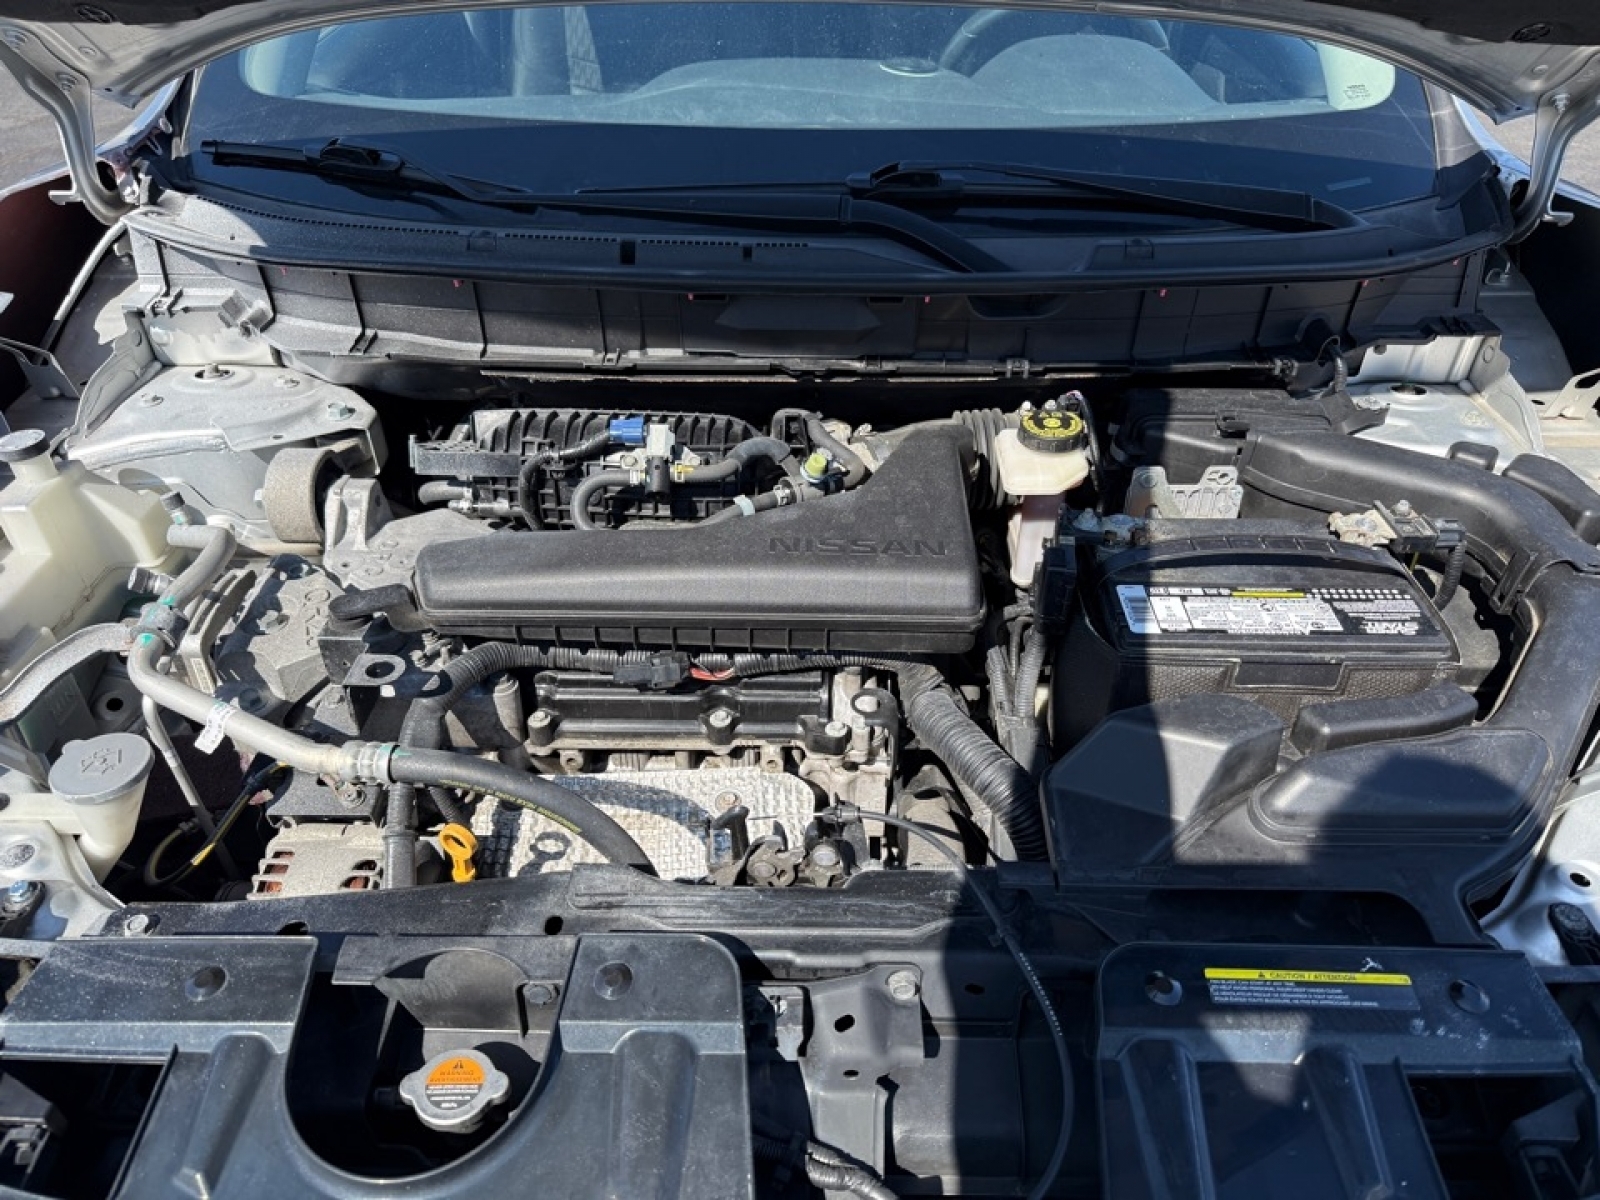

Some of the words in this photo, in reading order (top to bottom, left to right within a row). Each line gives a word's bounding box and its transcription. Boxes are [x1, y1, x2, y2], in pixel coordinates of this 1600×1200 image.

[768, 536, 947, 558] NISSAN
[1269, 972, 1306, 980] CAUTION
[1313, 973, 1356, 981] ATTENTION
